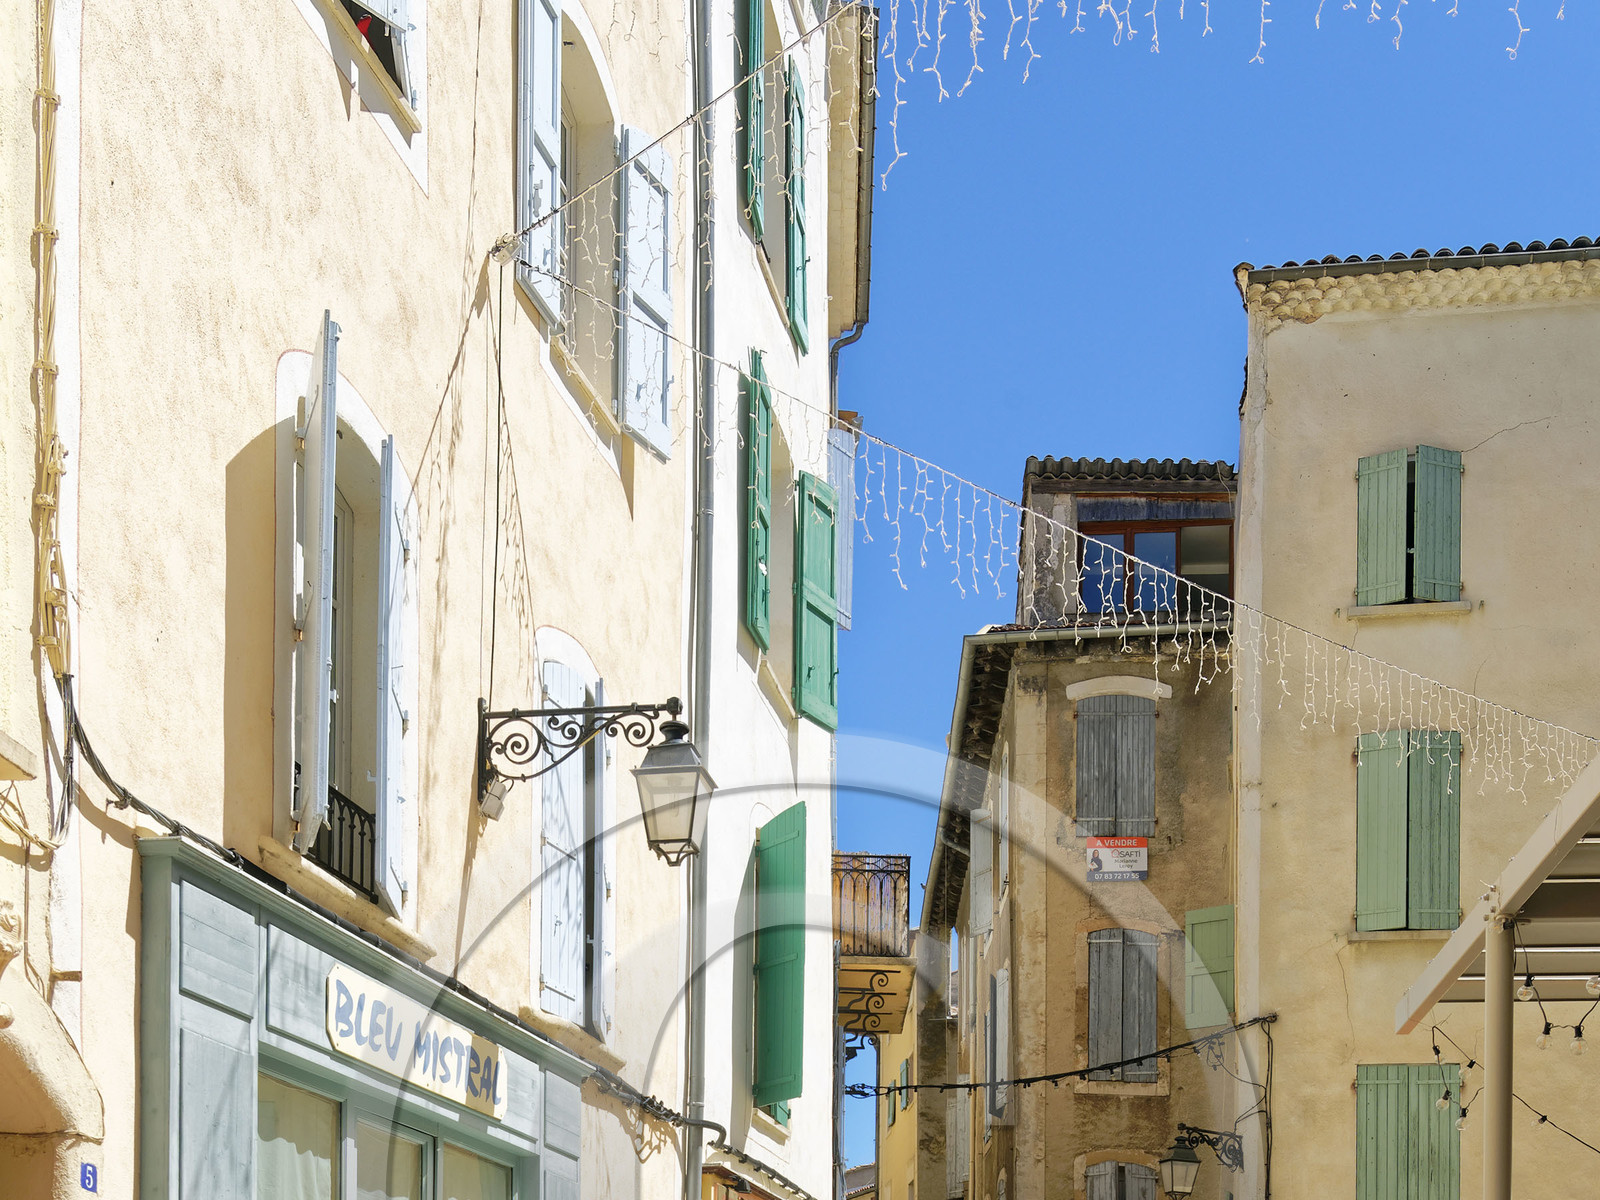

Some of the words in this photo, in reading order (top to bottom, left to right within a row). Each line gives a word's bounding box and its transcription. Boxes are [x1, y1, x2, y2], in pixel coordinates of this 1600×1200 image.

[335, 979, 403, 1062] BLEU
[413, 1020, 502, 1106] MISTRAL
[85, 1165, 94, 1189] 5
